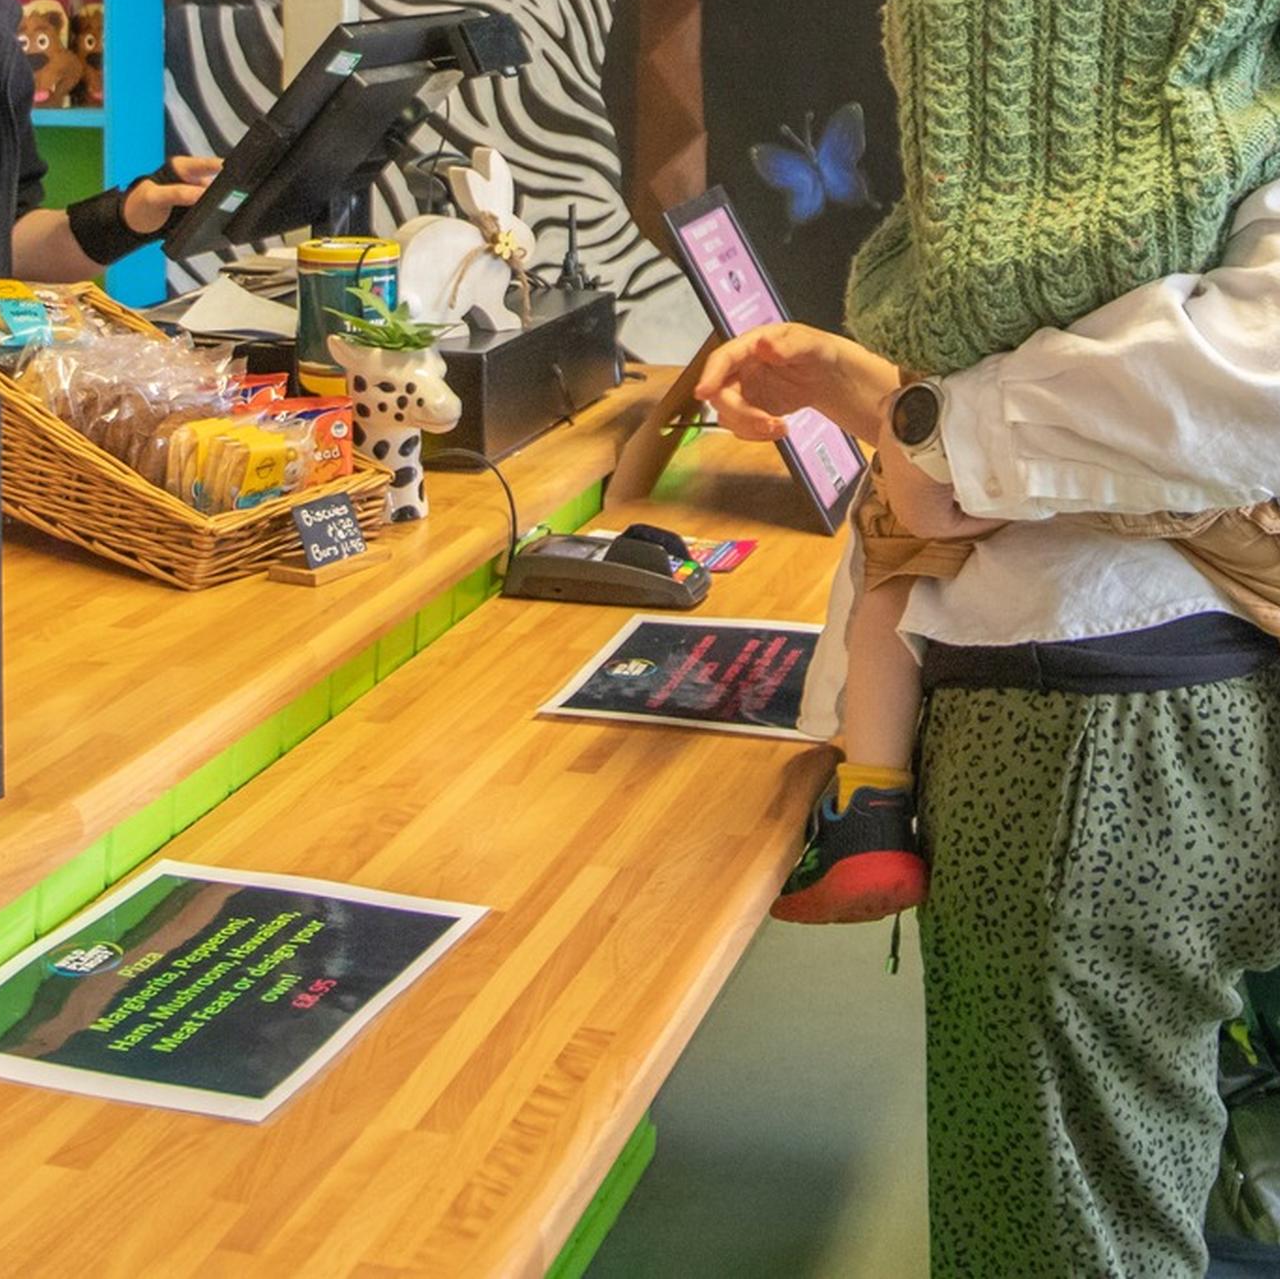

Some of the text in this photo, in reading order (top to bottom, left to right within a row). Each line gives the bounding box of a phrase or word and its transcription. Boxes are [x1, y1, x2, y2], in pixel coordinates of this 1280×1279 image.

[311, 543, 339, 562] Bars
[88, 916, 257, 1032] Margherita, Pepperoni,
[116, 952, 165, 978] Pizza
[107, 911, 302, 1052] Ham, Mushroom, Hawaiian,
[151, 919, 326, 1052] Meat Feast or design your
[260, 972, 303, 1003] own!
[291, 978, 338, 1009] £8.95
